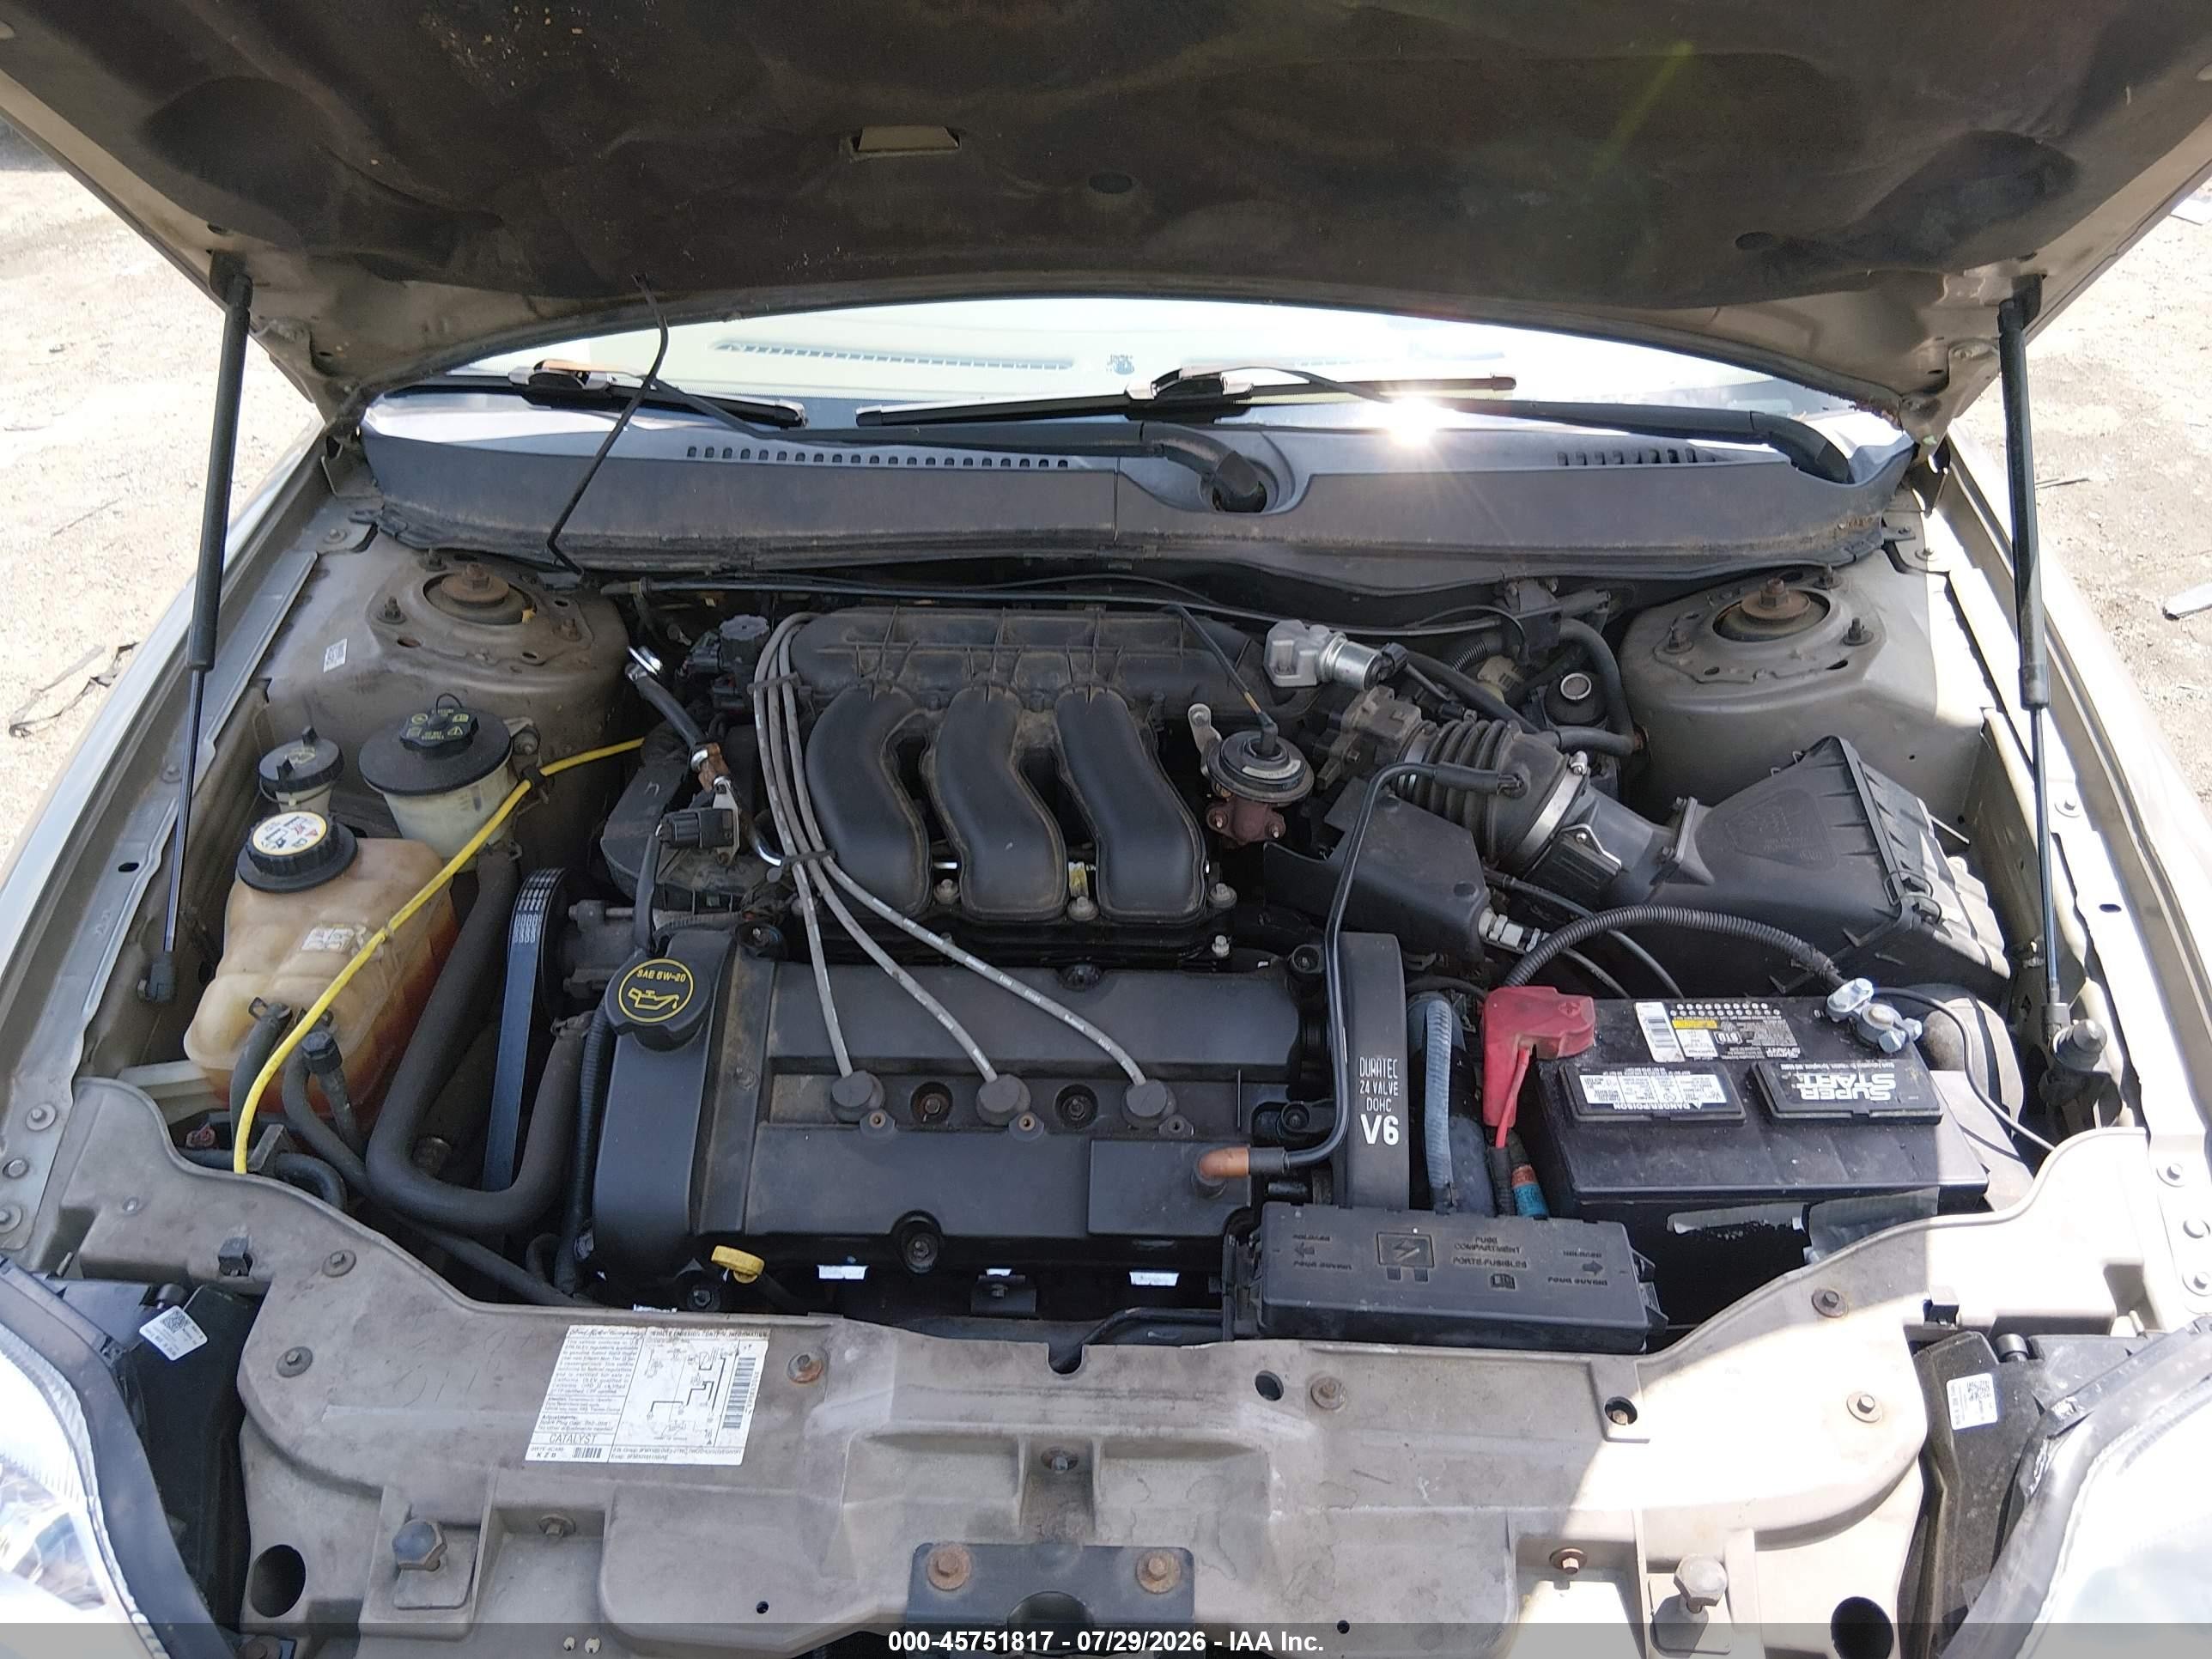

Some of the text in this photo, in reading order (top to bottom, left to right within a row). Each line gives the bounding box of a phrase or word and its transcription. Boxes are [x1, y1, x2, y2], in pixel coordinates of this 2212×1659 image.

[636, 969, 655, 980] SAE
[1359, 1056, 1399, 1079] DURATEC
[1359, 1080, 1399, 1097] 24 VALVE
[1796, 1073, 1896, 1089] START
[1801, 1086, 1893, 1101] SUPER
[1366, 1097, 1392, 1112] DOHC
[1360, 1113, 1400, 1146] V6
[1454, 1243, 1522, 1255] COMPARTMENT
[549, 1433, 597, 1444] CATALYST
